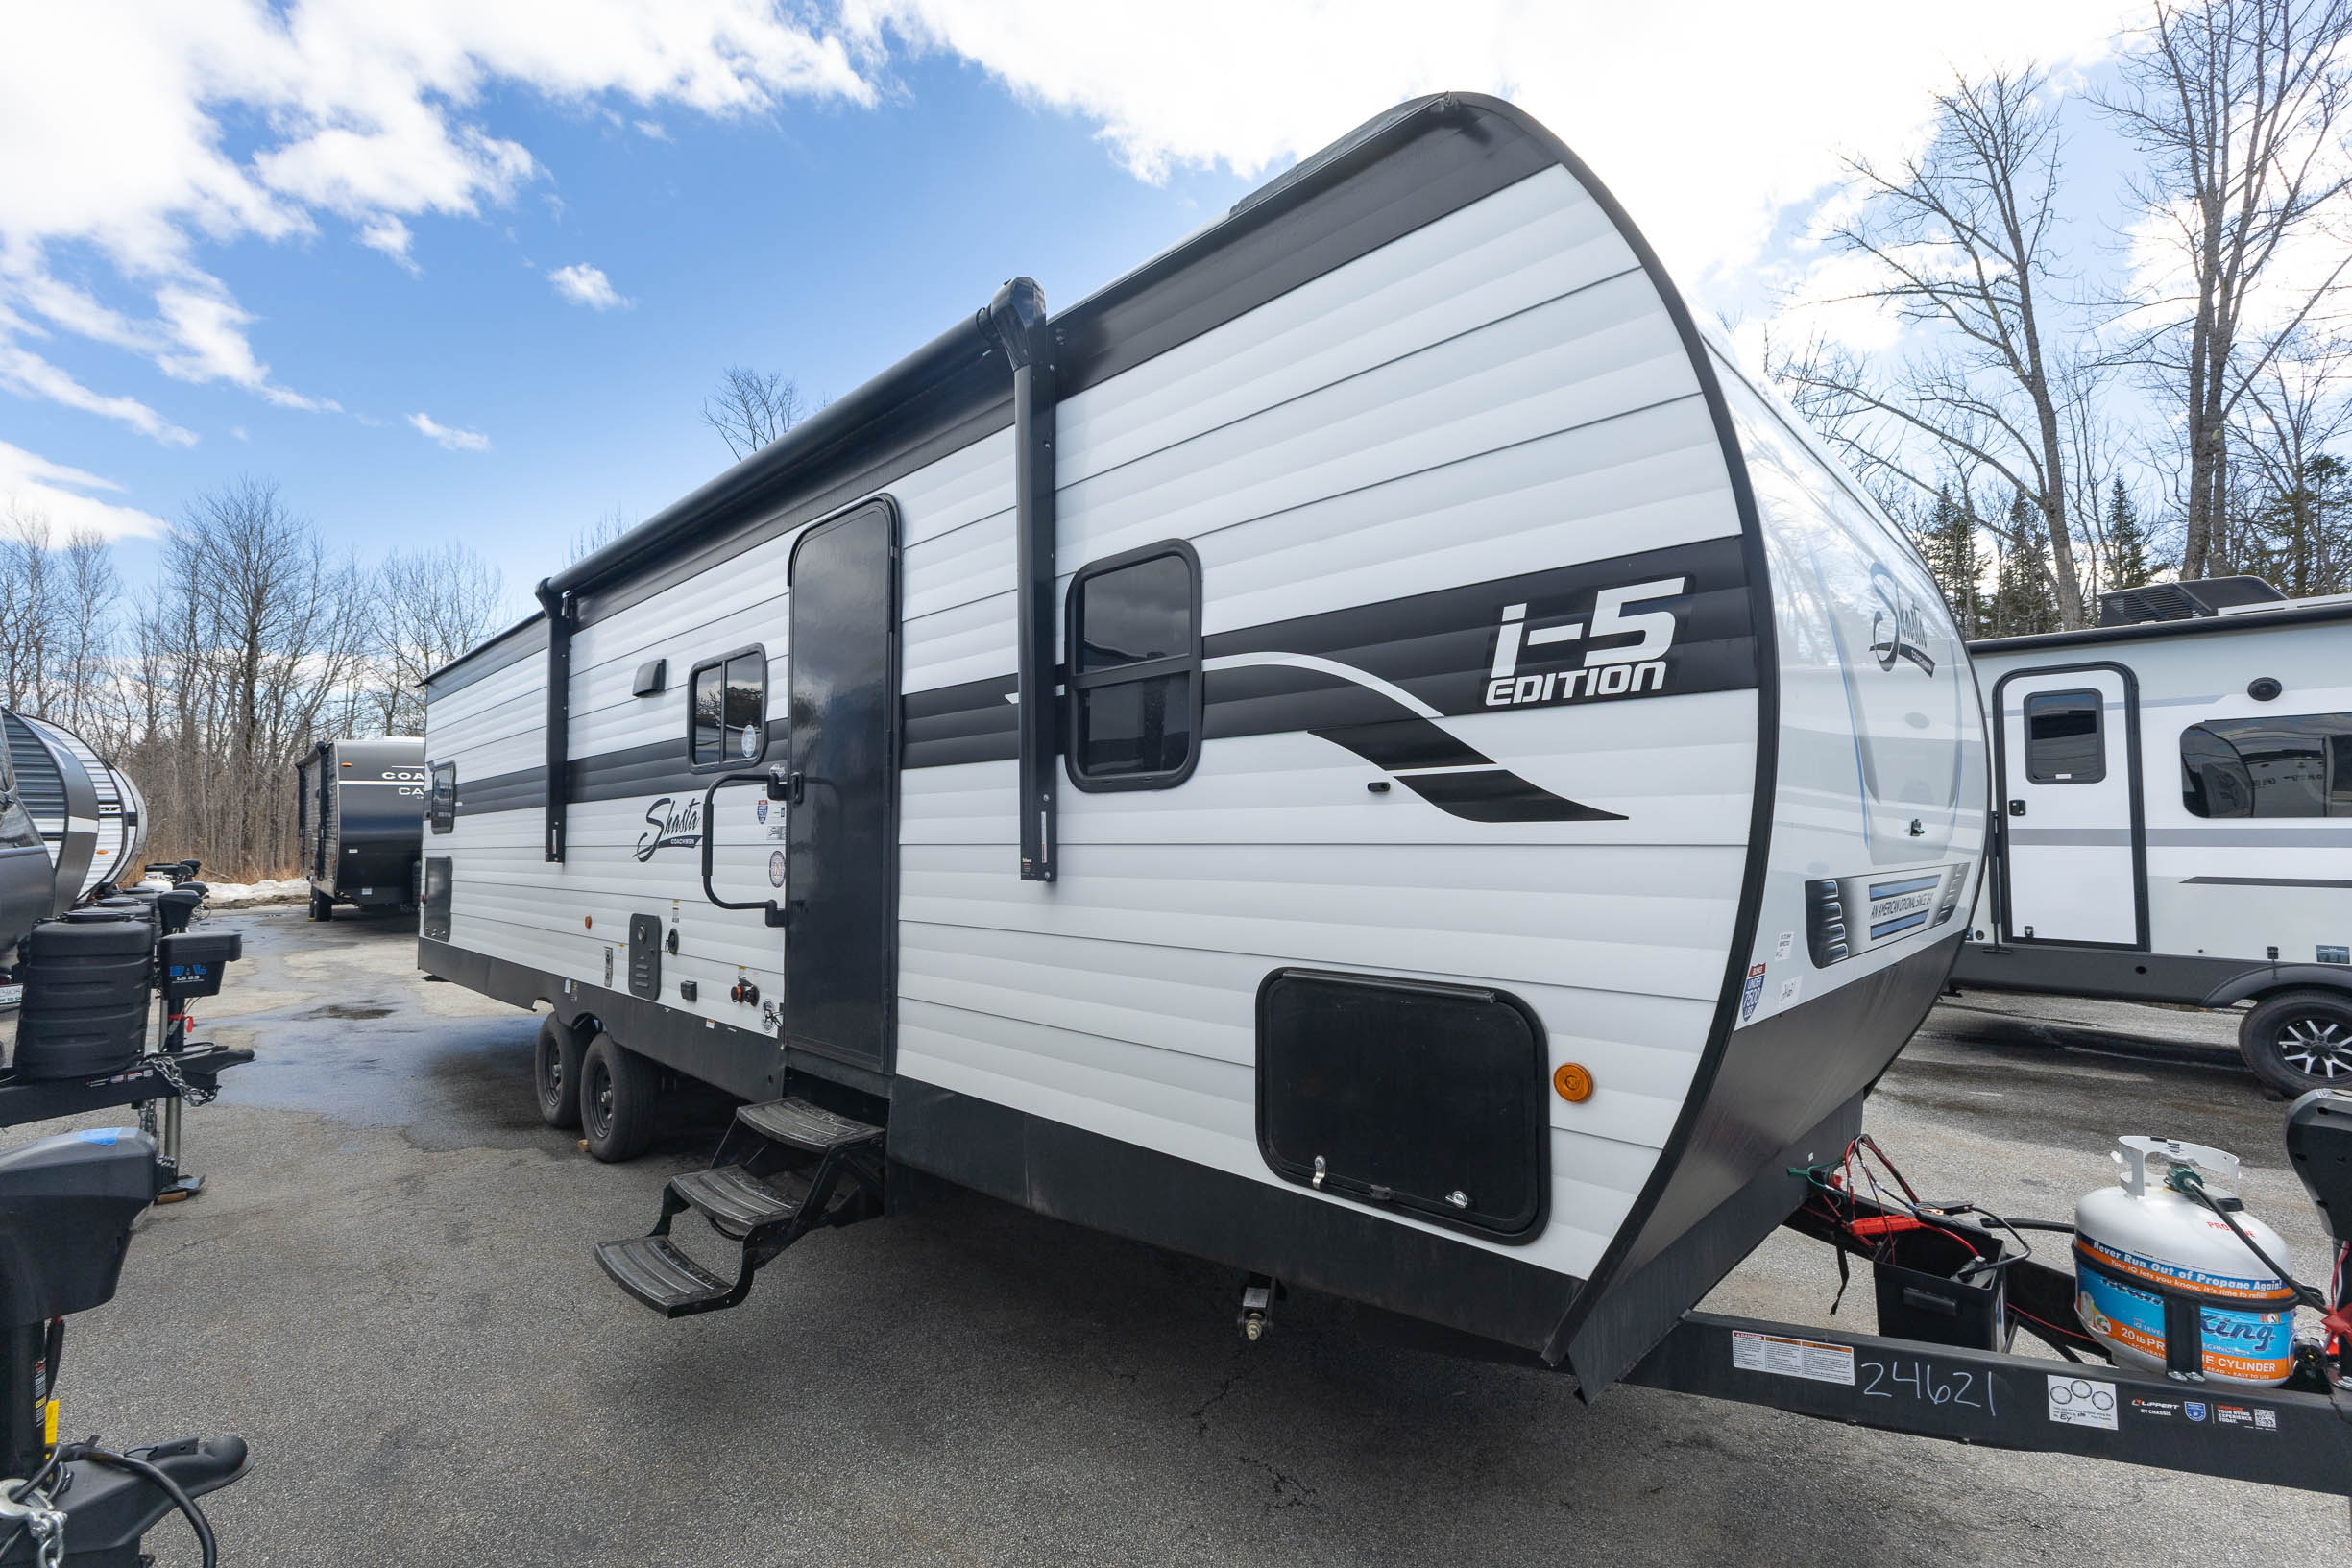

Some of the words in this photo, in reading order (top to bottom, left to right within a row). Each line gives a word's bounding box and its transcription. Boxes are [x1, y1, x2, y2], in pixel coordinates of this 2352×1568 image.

[1491, 577, 1685, 679] i-5
[1869, 562, 1928, 672] Shasta
[630, 797, 701, 863] Shasta
[2093, 1241, 2122, 1259] Never
[2123, 1252, 2146, 1268] Run
[2150, 1262, 2174, 1277] Out
[2179, 1269, 2194, 1281] of
[2196, 1272, 2250, 1290] Propane
[2252, 1279, 2282, 1293] Again!
[2110, 1259, 2126, 1270] Your
[2139, 1266, 2154, 1281] lets
[2155, 1273, 2172, 1286] you
[2219, 1288, 2237, 1298] time
[2239, 1291, 2247, 1299] to
[2121, 1327, 2135, 1340] 20
[2135, 1334, 2146, 1345] lb
[2218, 1357, 2276, 1373] CYLINDER
[1860, 1360, 1997, 1417] 24621
